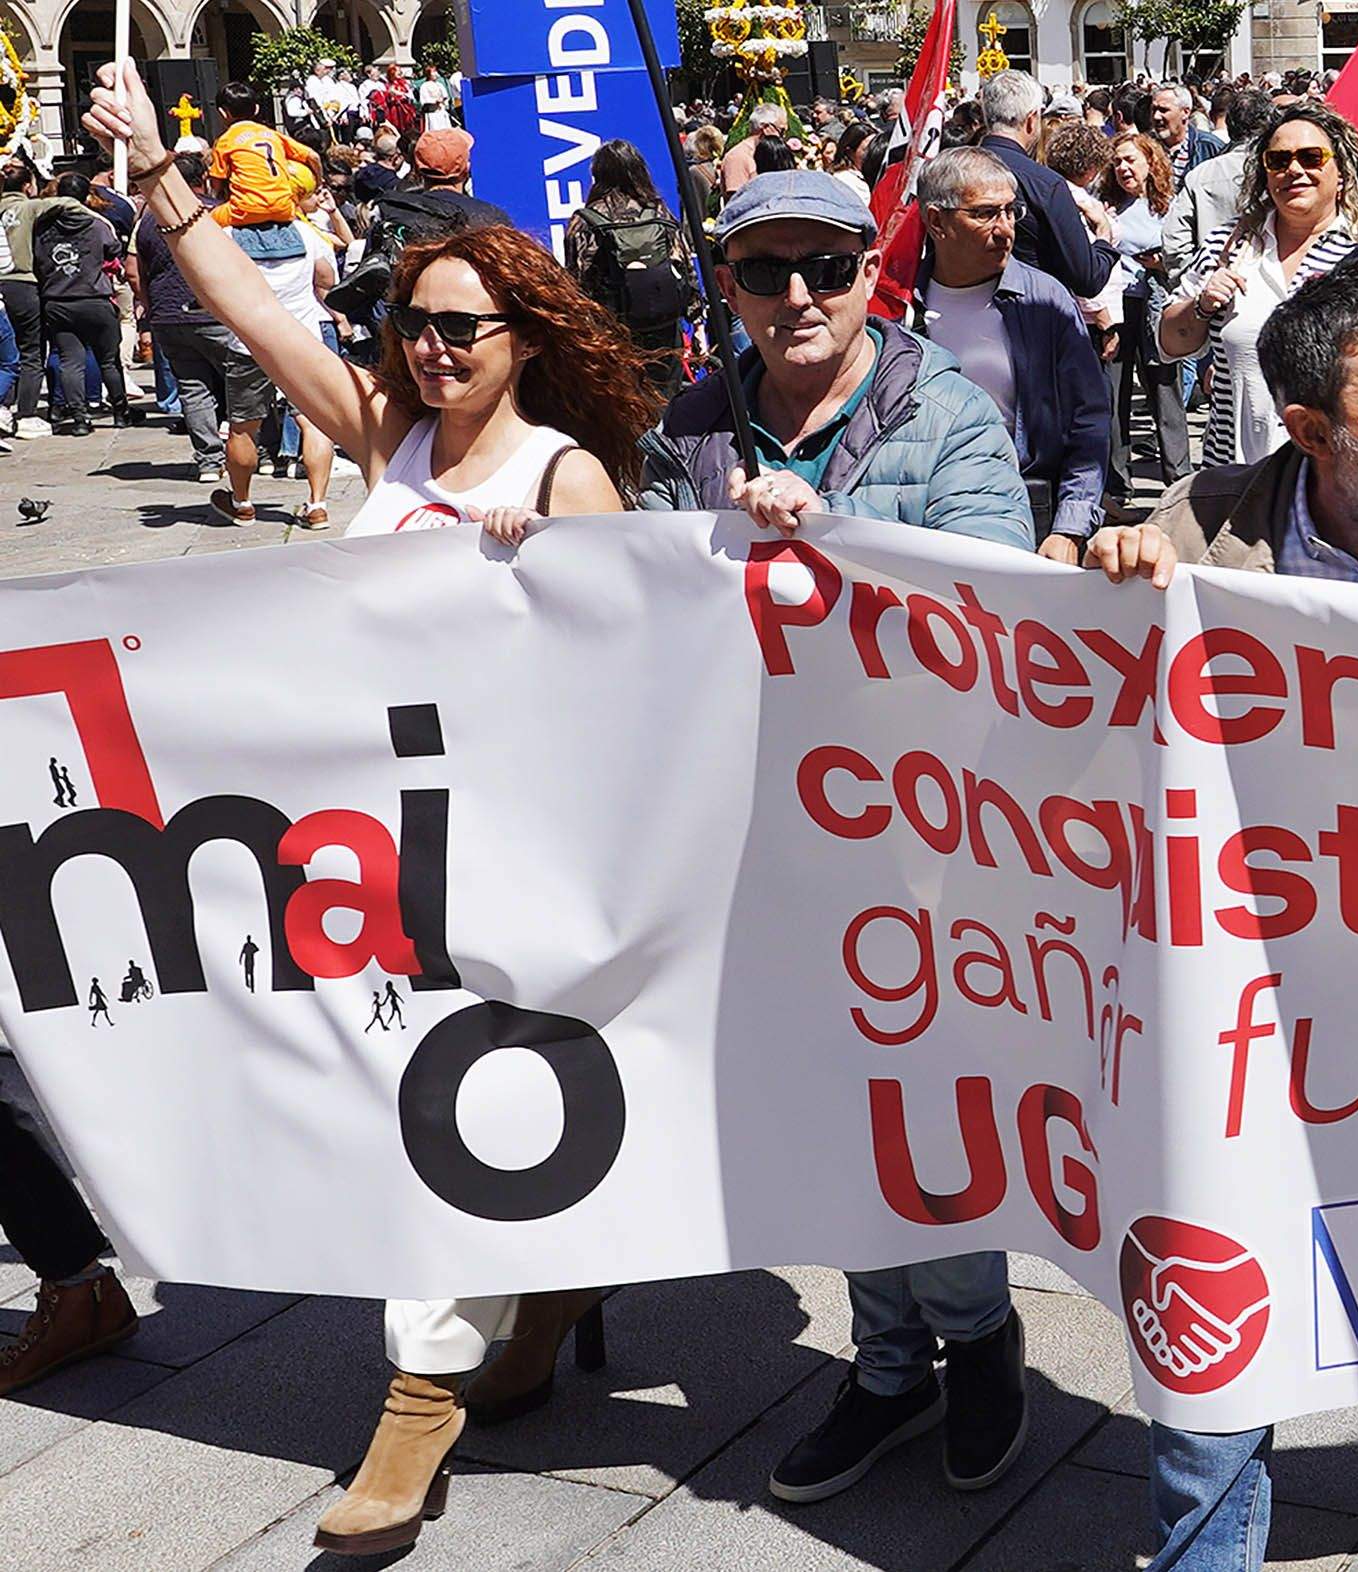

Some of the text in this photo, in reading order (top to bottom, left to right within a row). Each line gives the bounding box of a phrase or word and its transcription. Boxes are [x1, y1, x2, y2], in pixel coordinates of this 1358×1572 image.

[254, 142, 278, 177] 7
[842, 905, 1144, 1108] gañar
[868, 1076, 1101, 1252] UG
